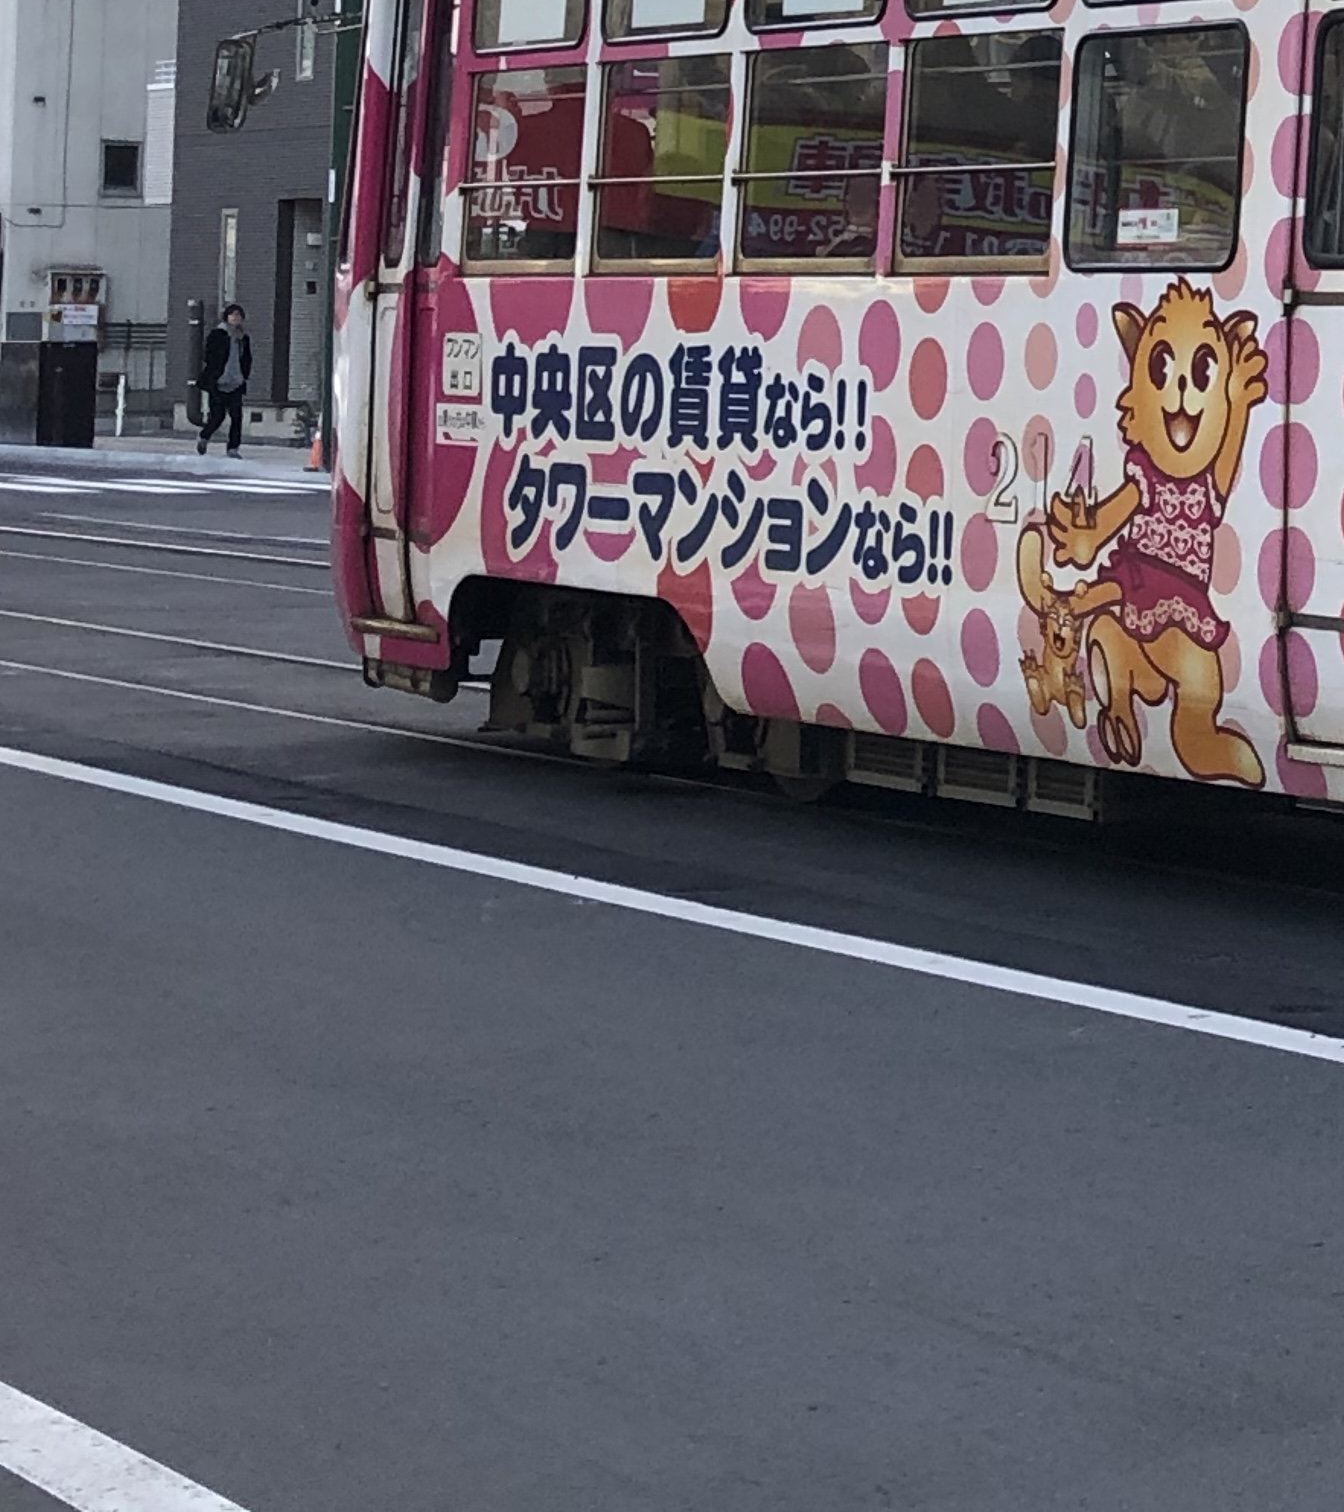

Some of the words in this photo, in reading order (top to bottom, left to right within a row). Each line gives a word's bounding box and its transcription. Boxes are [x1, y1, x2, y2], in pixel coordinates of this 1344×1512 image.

[491, 341, 868, 452] 中央区の賃貸なら!!
[508, 453, 954, 586] タワーマンションなら!!
